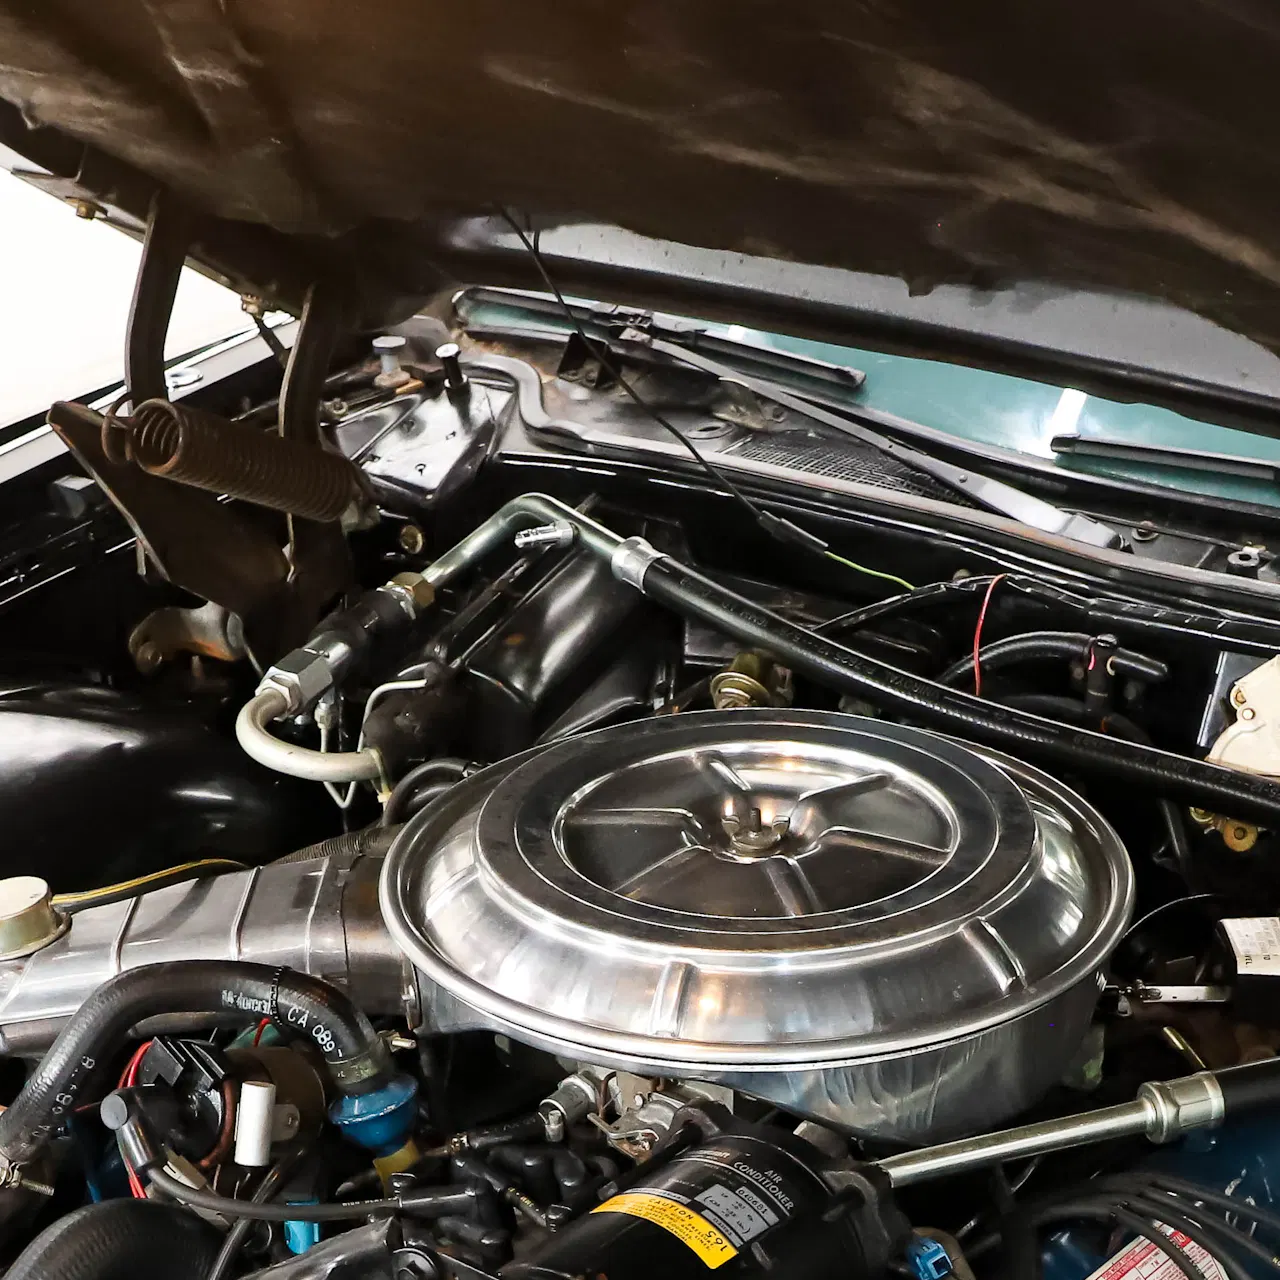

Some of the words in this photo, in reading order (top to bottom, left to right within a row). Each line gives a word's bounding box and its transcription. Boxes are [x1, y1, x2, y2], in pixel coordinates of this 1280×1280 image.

[286, 1006, 310, 1029] CA
[733, 1161, 795, 1211] CONDITIONER
[764, 1168, 784, 1185] AIR
[648, 1198, 694, 1221] CAUTION
